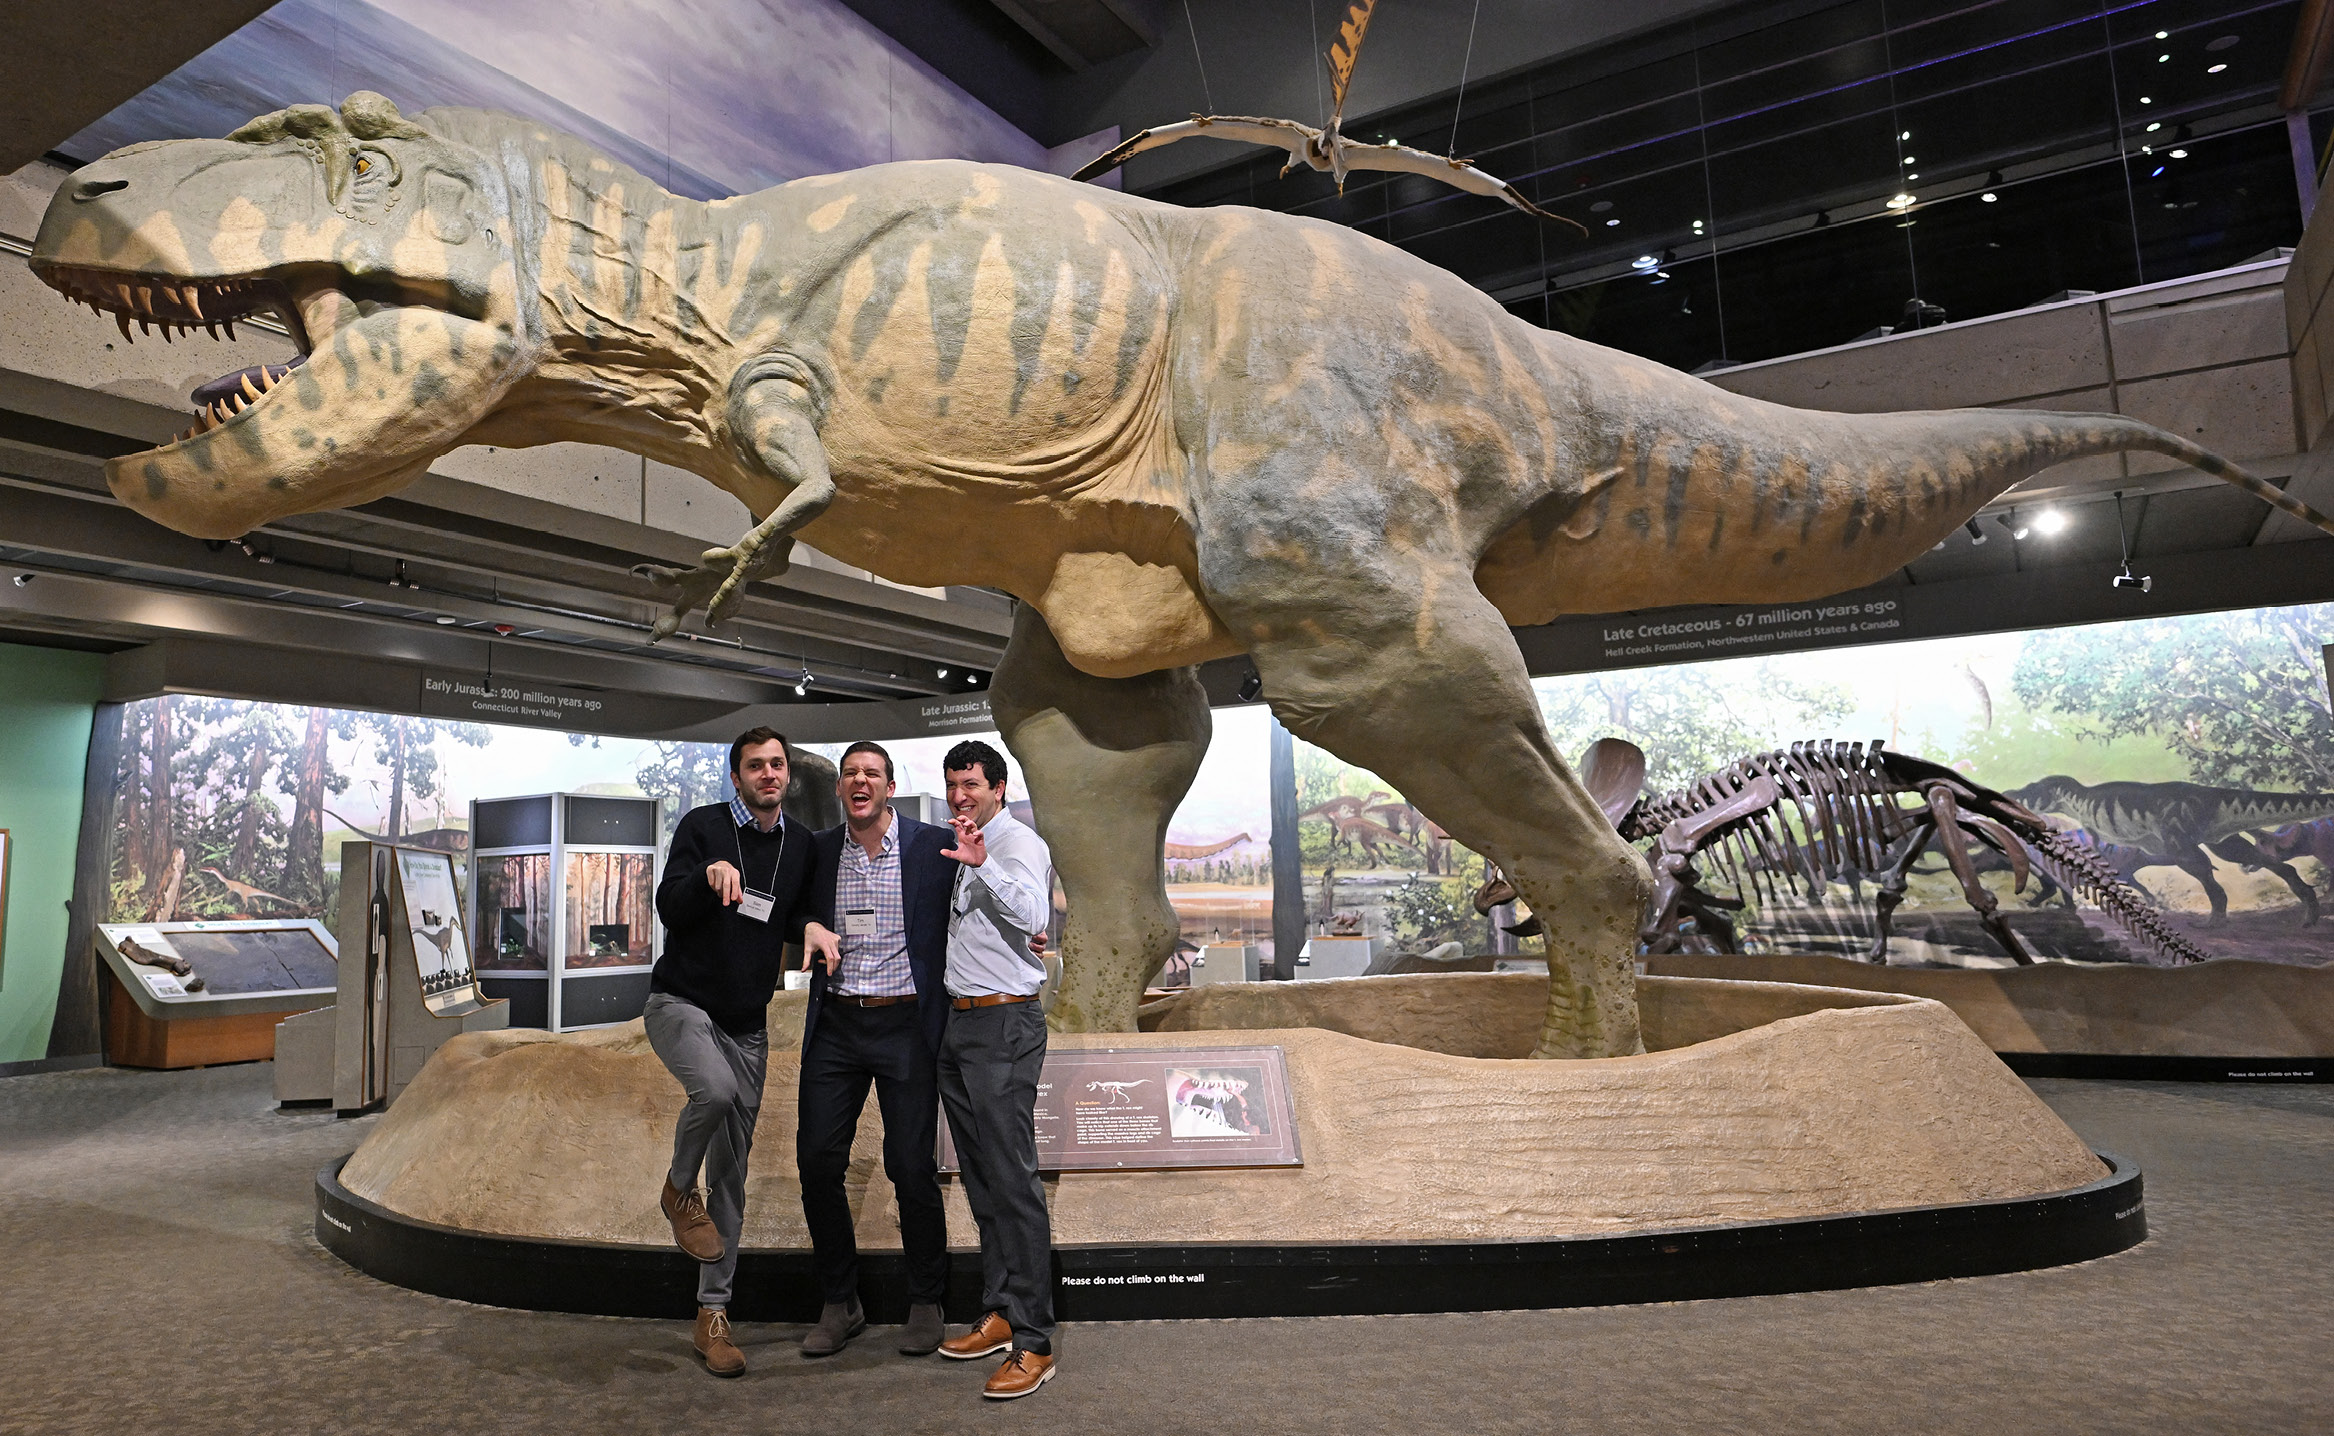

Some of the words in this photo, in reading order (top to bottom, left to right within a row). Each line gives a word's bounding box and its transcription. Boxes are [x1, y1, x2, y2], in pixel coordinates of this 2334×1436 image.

[1603, 628, 1634, 642] Late
[1638, 617, 1722, 638] Cretaceous
[1735, 613, 1754, 628] 67
[1758, 607, 1812, 625] million
[1816, 603, 1860, 621] years
[1864, 600, 1897, 616] ago
[1605, 647, 1624, 657] Hell
[1626, 644, 1653, 656] Creek
[1655, 638, 1705, 653] Formation,
[1707, 631, 1775, 648] Northwestern
[1777, 626, 1812, 641] United
[1814, 623, 1848, 636] States
[1850, 622, 1858, 632] &
[1860, 618, 1900, 631] Canada
[425, 678, 451, 694] Early
[454, 681, 498, 698] Jurassc:
[501, 687, 520, 700] 200
[523, 690, 556, 705] million
[558, 696, 582, 709] years
[584, 700, 602, 711] ago
[472, 700, 519, 714] Connecticut
[521, 706, 539, 716] River
[540, 708, 562, 720] Valley
[921, 706, 940, 717] Late
[942, 701, 980, 715] Jurassic:
[928, 718, 958, 727] Morrison
[1061, 1276, 1092, 1286] Please
[1093, 1275, 1106, 1285] do
[1108, 1275, 1125, 1285] not
[1126, 1274, 1152, 1284] climb
[1153, 1274, 1167, 1284] on
[1168, 1273, 1185, 1283] the
[1186, 1273, 1205, 1283] wall
